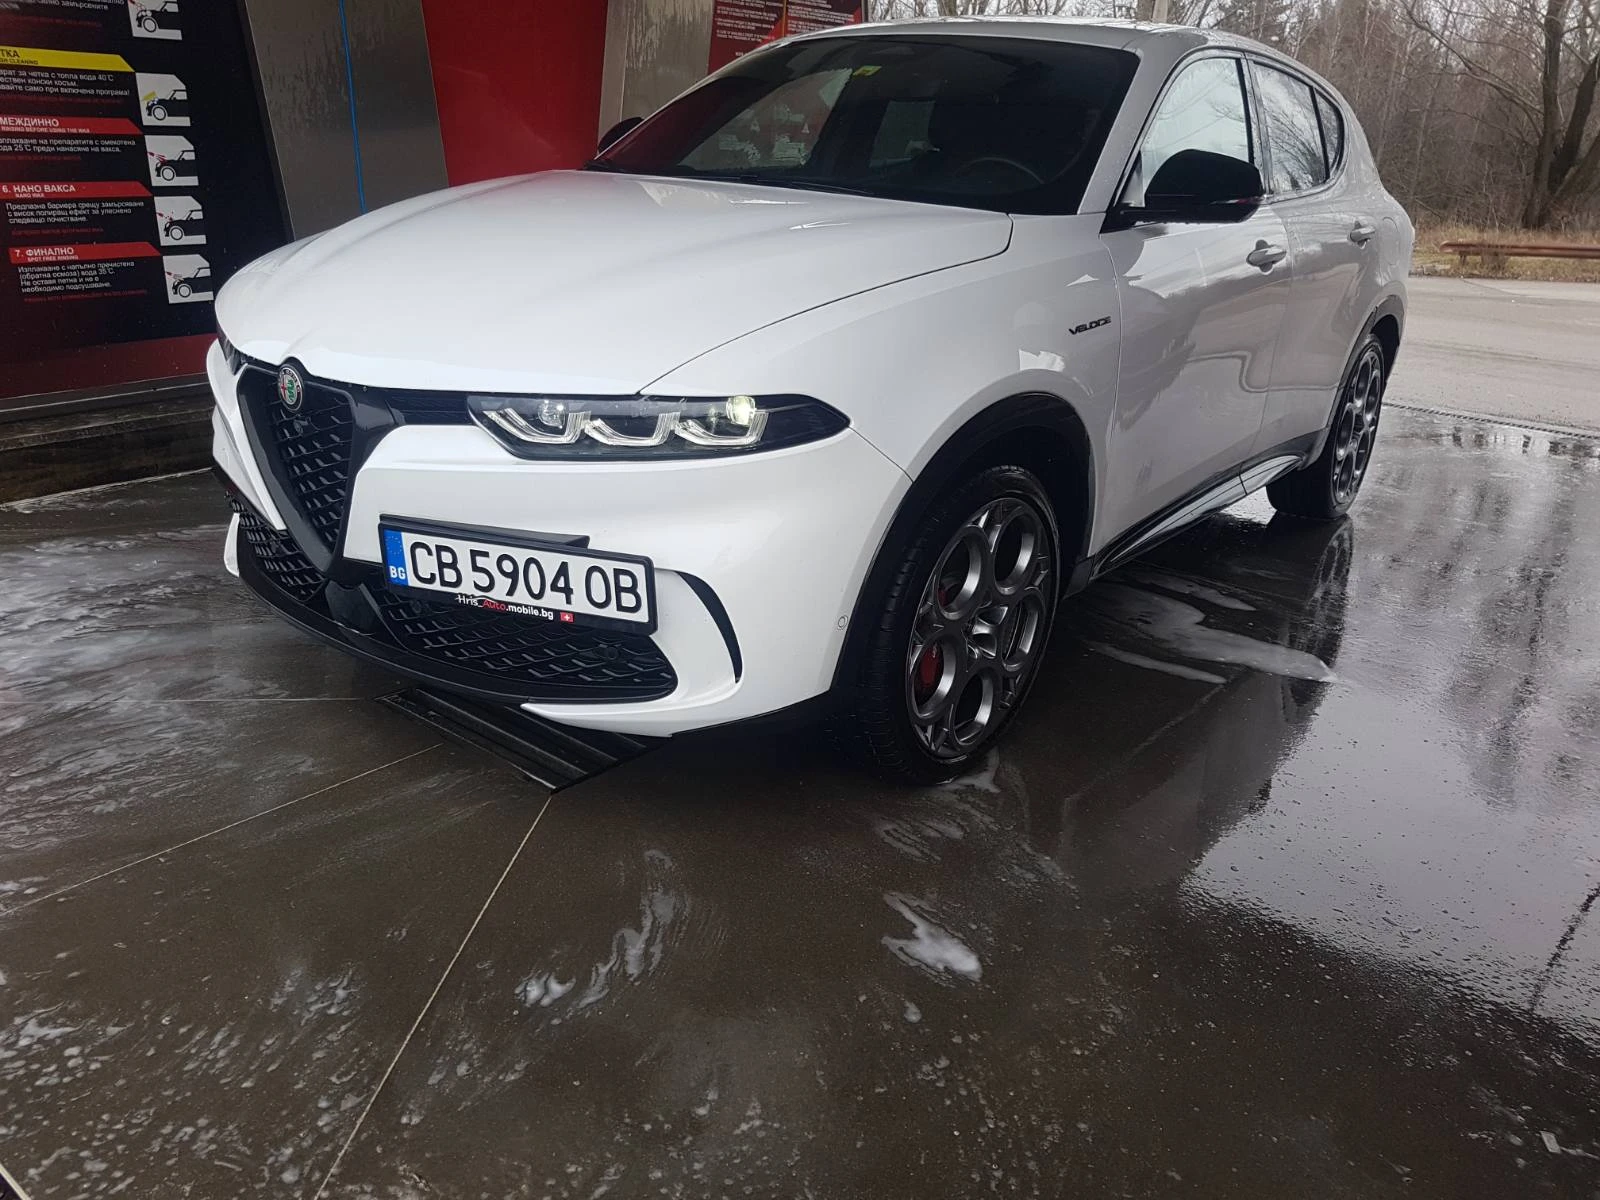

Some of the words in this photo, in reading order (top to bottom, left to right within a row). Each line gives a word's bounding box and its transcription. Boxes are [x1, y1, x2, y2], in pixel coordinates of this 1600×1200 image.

[13, 184, 42, 193] НАНО
[44, 184, 77, 193] ВАКСА
[6, 202, 46, 211] Предпазна
[47, 202, 77, 210] бариера
[26, 247, 74, 257] ФИНАЛНО
[389, 565, 407, 581] BG
[410, 541, 463, 589] CB
[470, 549, 574, 606] 5904
[585, 565, 643, 615] OB
